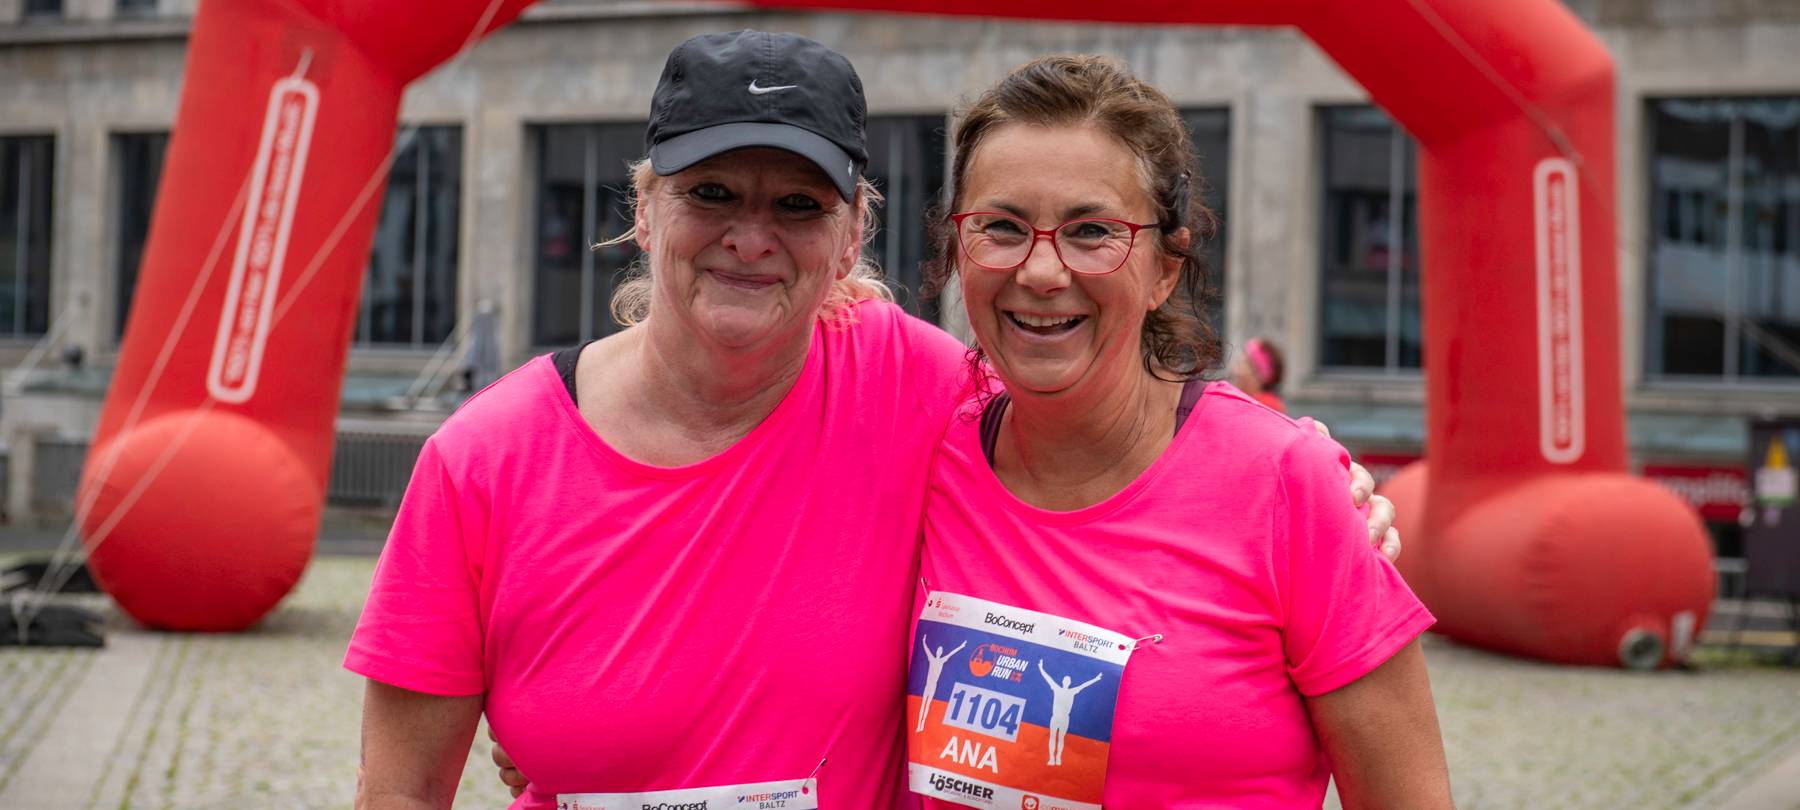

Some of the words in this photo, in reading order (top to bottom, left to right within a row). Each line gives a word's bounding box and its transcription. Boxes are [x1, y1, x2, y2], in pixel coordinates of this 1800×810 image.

[985, 612, 1034, 635] BoConcept
[1065, 631, 1114, 649] INTERSPORT
[1074, 641, 1099, 654] BALTZ
[996, 655, 1029, 672] URBAN
[991, 666, 1012, 680] RUN
[951, 690, 1021, 736] 1104
[939, 736, 999, 774] ANA
[929, 773, 994, 800] LÖSCHER
[746, 790, 799, 803] INTERSPORT
[760, 800, 786, 809] BALTZ
